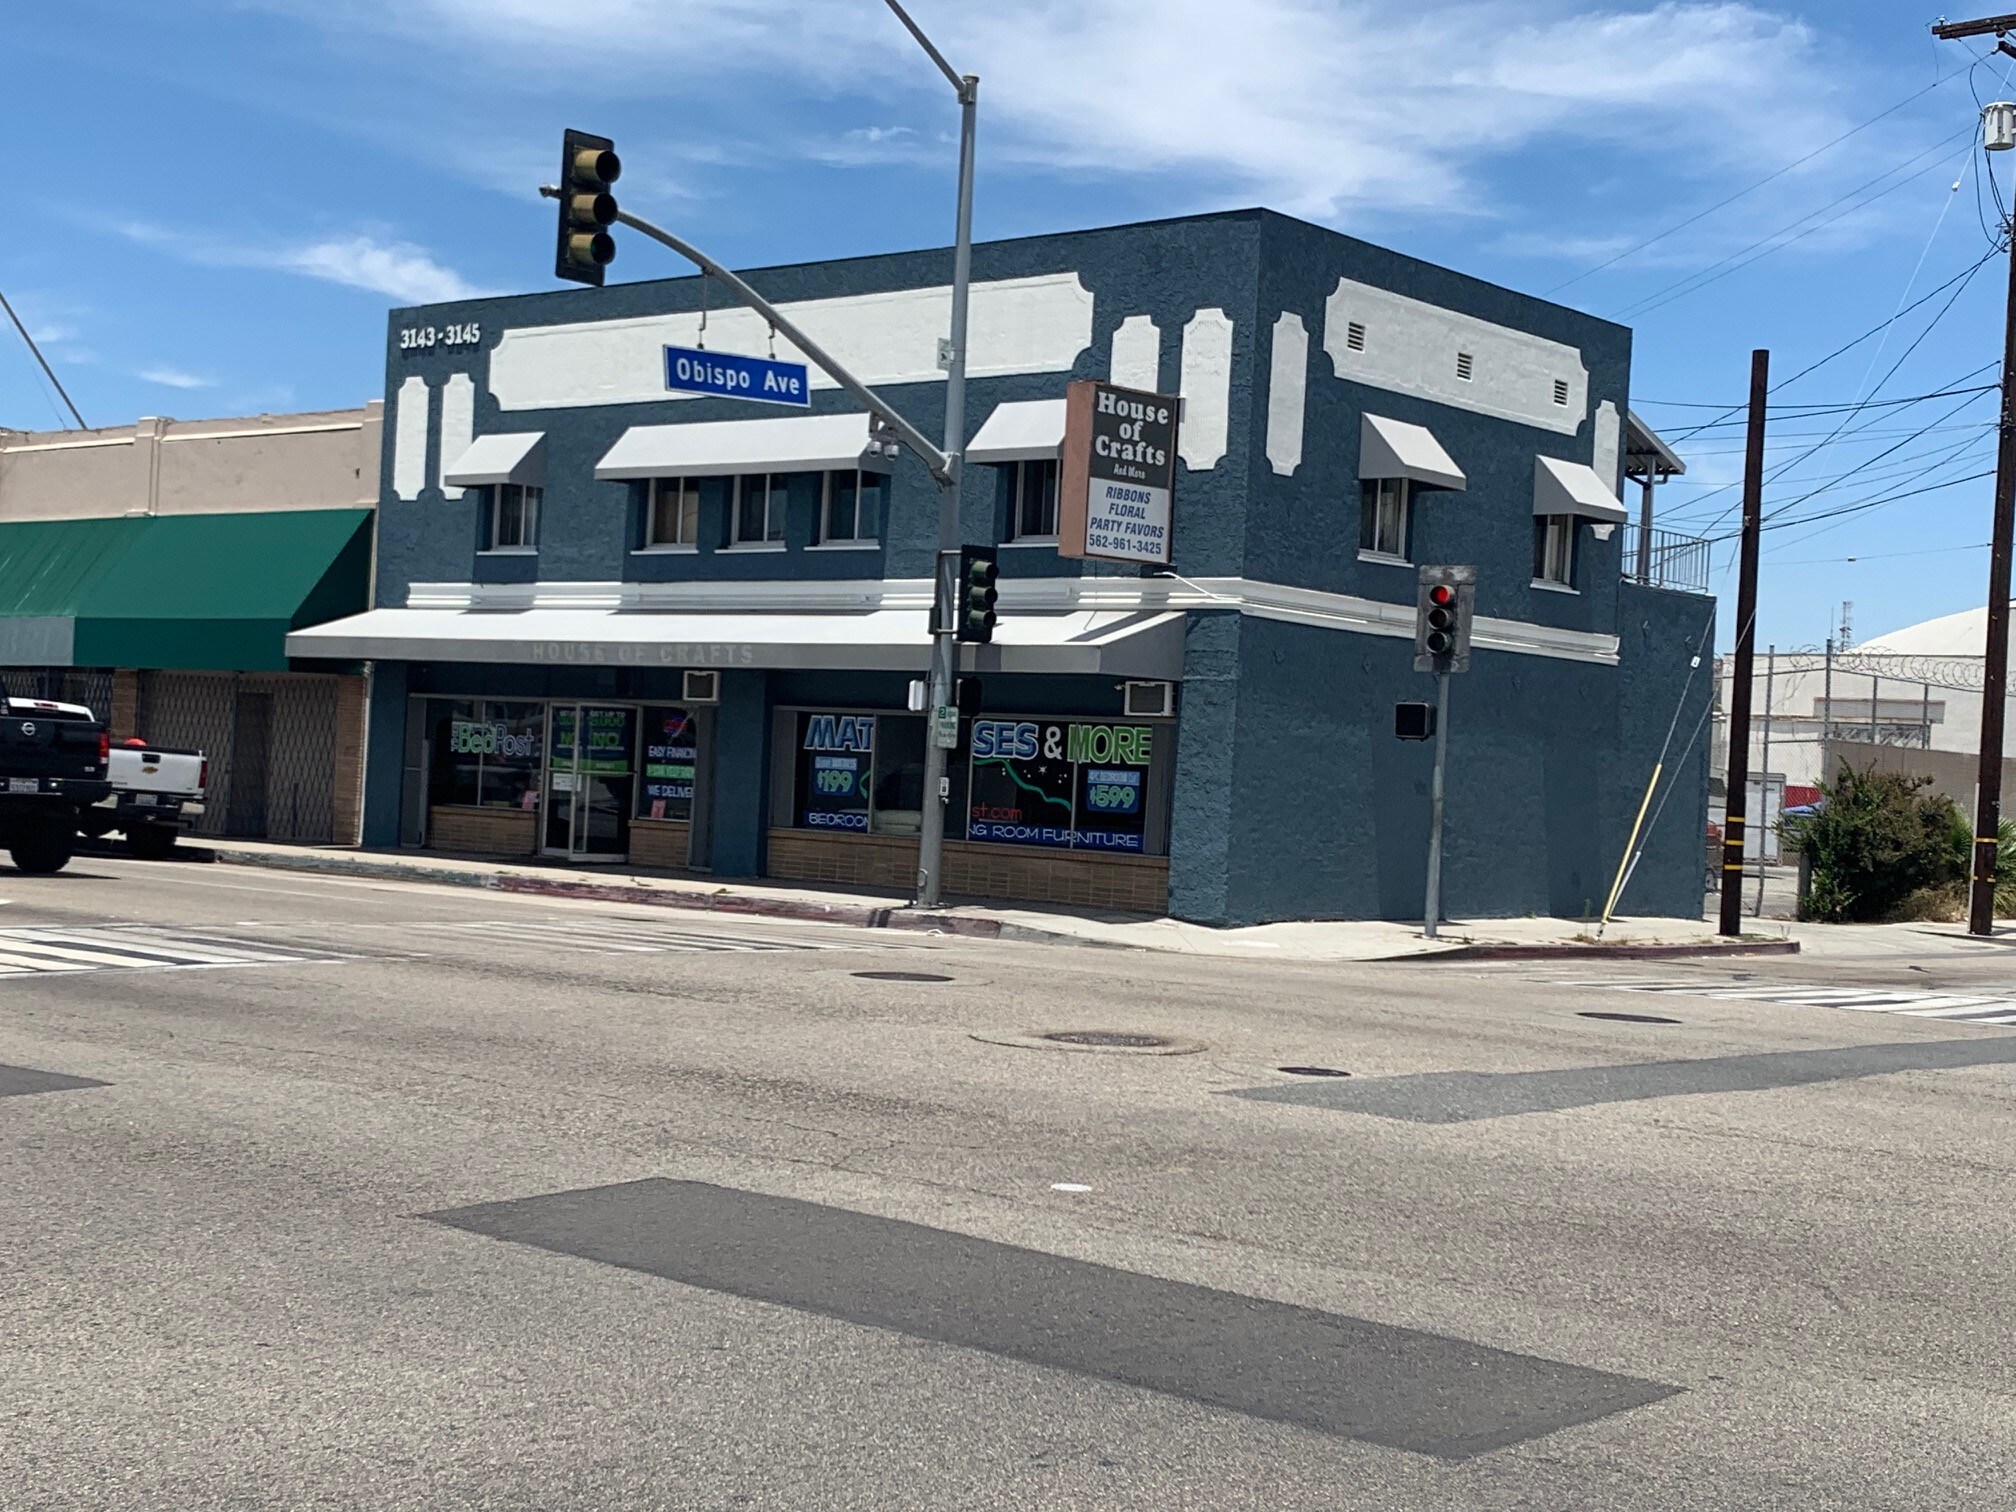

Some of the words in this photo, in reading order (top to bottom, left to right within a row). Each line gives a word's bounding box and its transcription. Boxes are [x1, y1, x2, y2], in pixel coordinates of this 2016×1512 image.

[676, 357, 751, 391] Obispo
[763, 369, 801, 395] Ave
[1097, 391, 1169, 425] House
[1118, 421, 1144, 442] of
[1094, 435, 1166, 466] Crafts
[1113, 463, 1127, 477] And
[1128, 465, 1146, 480] More
[1105, 486, 1151, 504] RIBBONS
[1108, 503, 1146, 519] FLORAL
[1090, 516, 1123, 533] PARTY
[1124, 521, 1165, 539] FAVORS
[1089, 534, 1162, 555] 562-961-3425
[533, 643, 604, 662] HOUSE
[618, 644, 646, 664] OF
[659, 644, 752, 664] CRAFTS
[803, 715, 875, 752] MAT
[972, 720, 1039, 761] SES
[1043, 725, 1063, 760] &
[1067, 724, 1152, 766] MORE
[647, 784, 660, 796] WE
[662, 785, 693, 798] DELIVE
[1089, 784, 1136, 809] $599
[992, 825, 1039, 839] ROOM
[1042, 827, 1139, 847] FURNITURE
